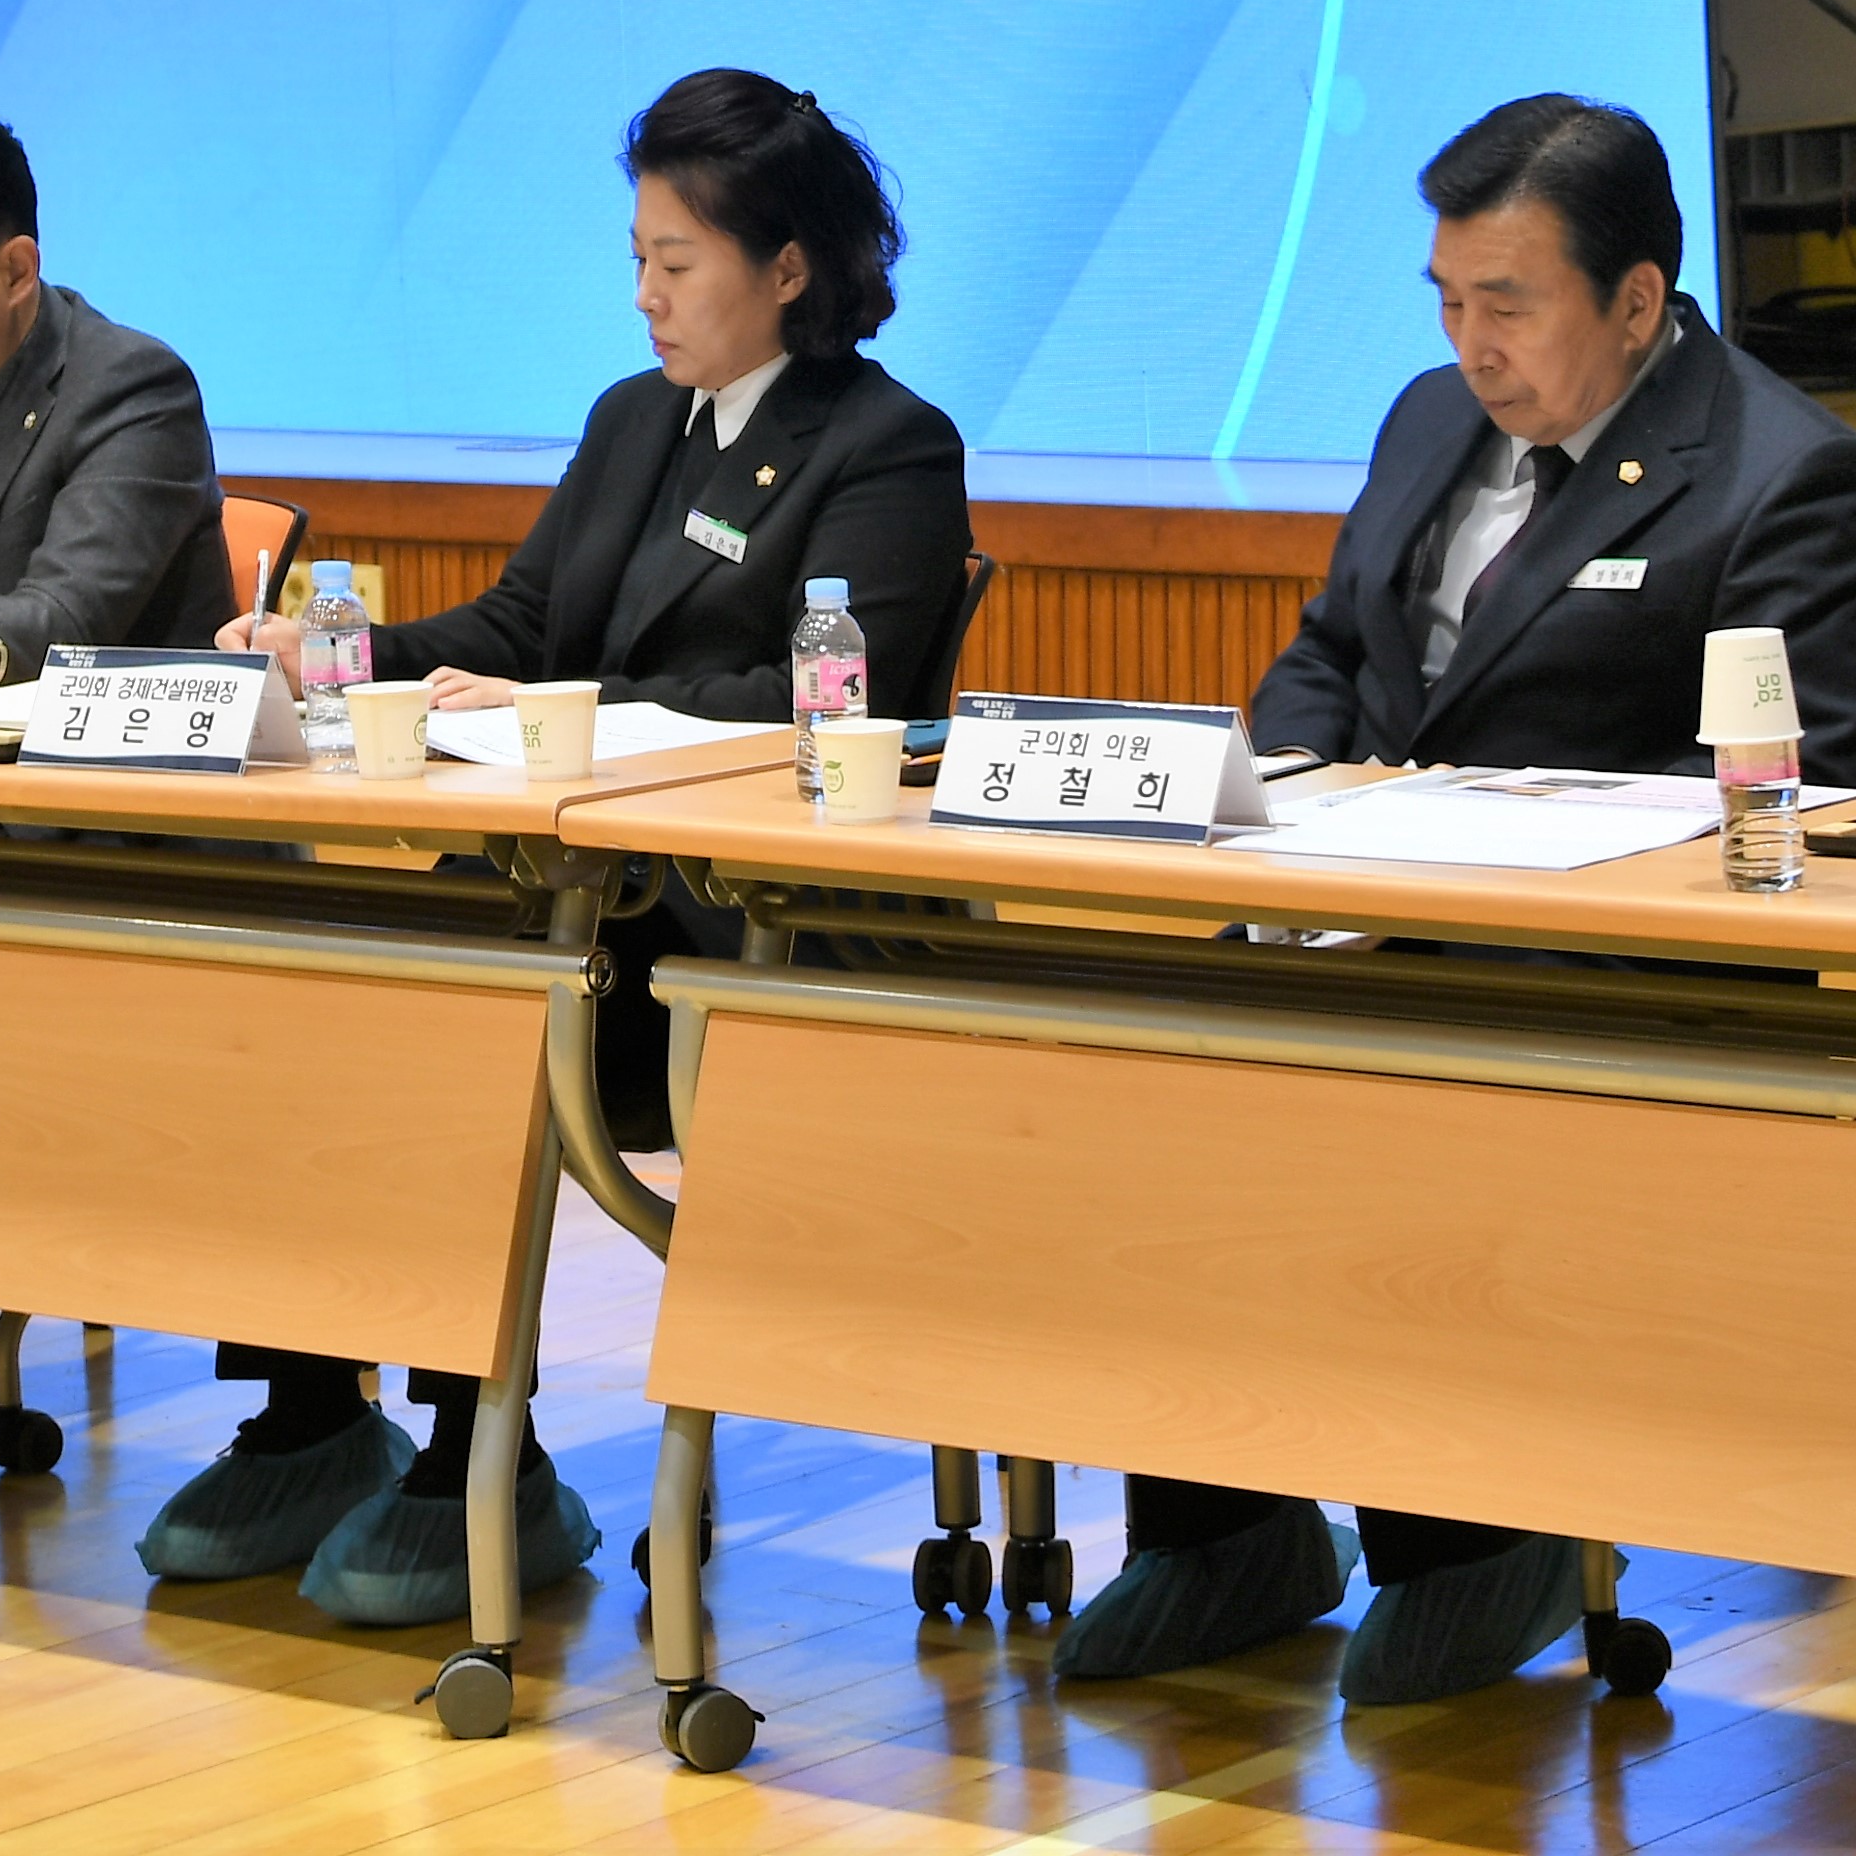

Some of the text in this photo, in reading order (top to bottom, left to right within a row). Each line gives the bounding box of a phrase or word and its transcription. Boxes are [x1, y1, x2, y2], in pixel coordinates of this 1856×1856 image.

[59, 674, 239, 705] 군의회 경제건설위원장
[1018, 729, 1151, 761] 군의회 의원
